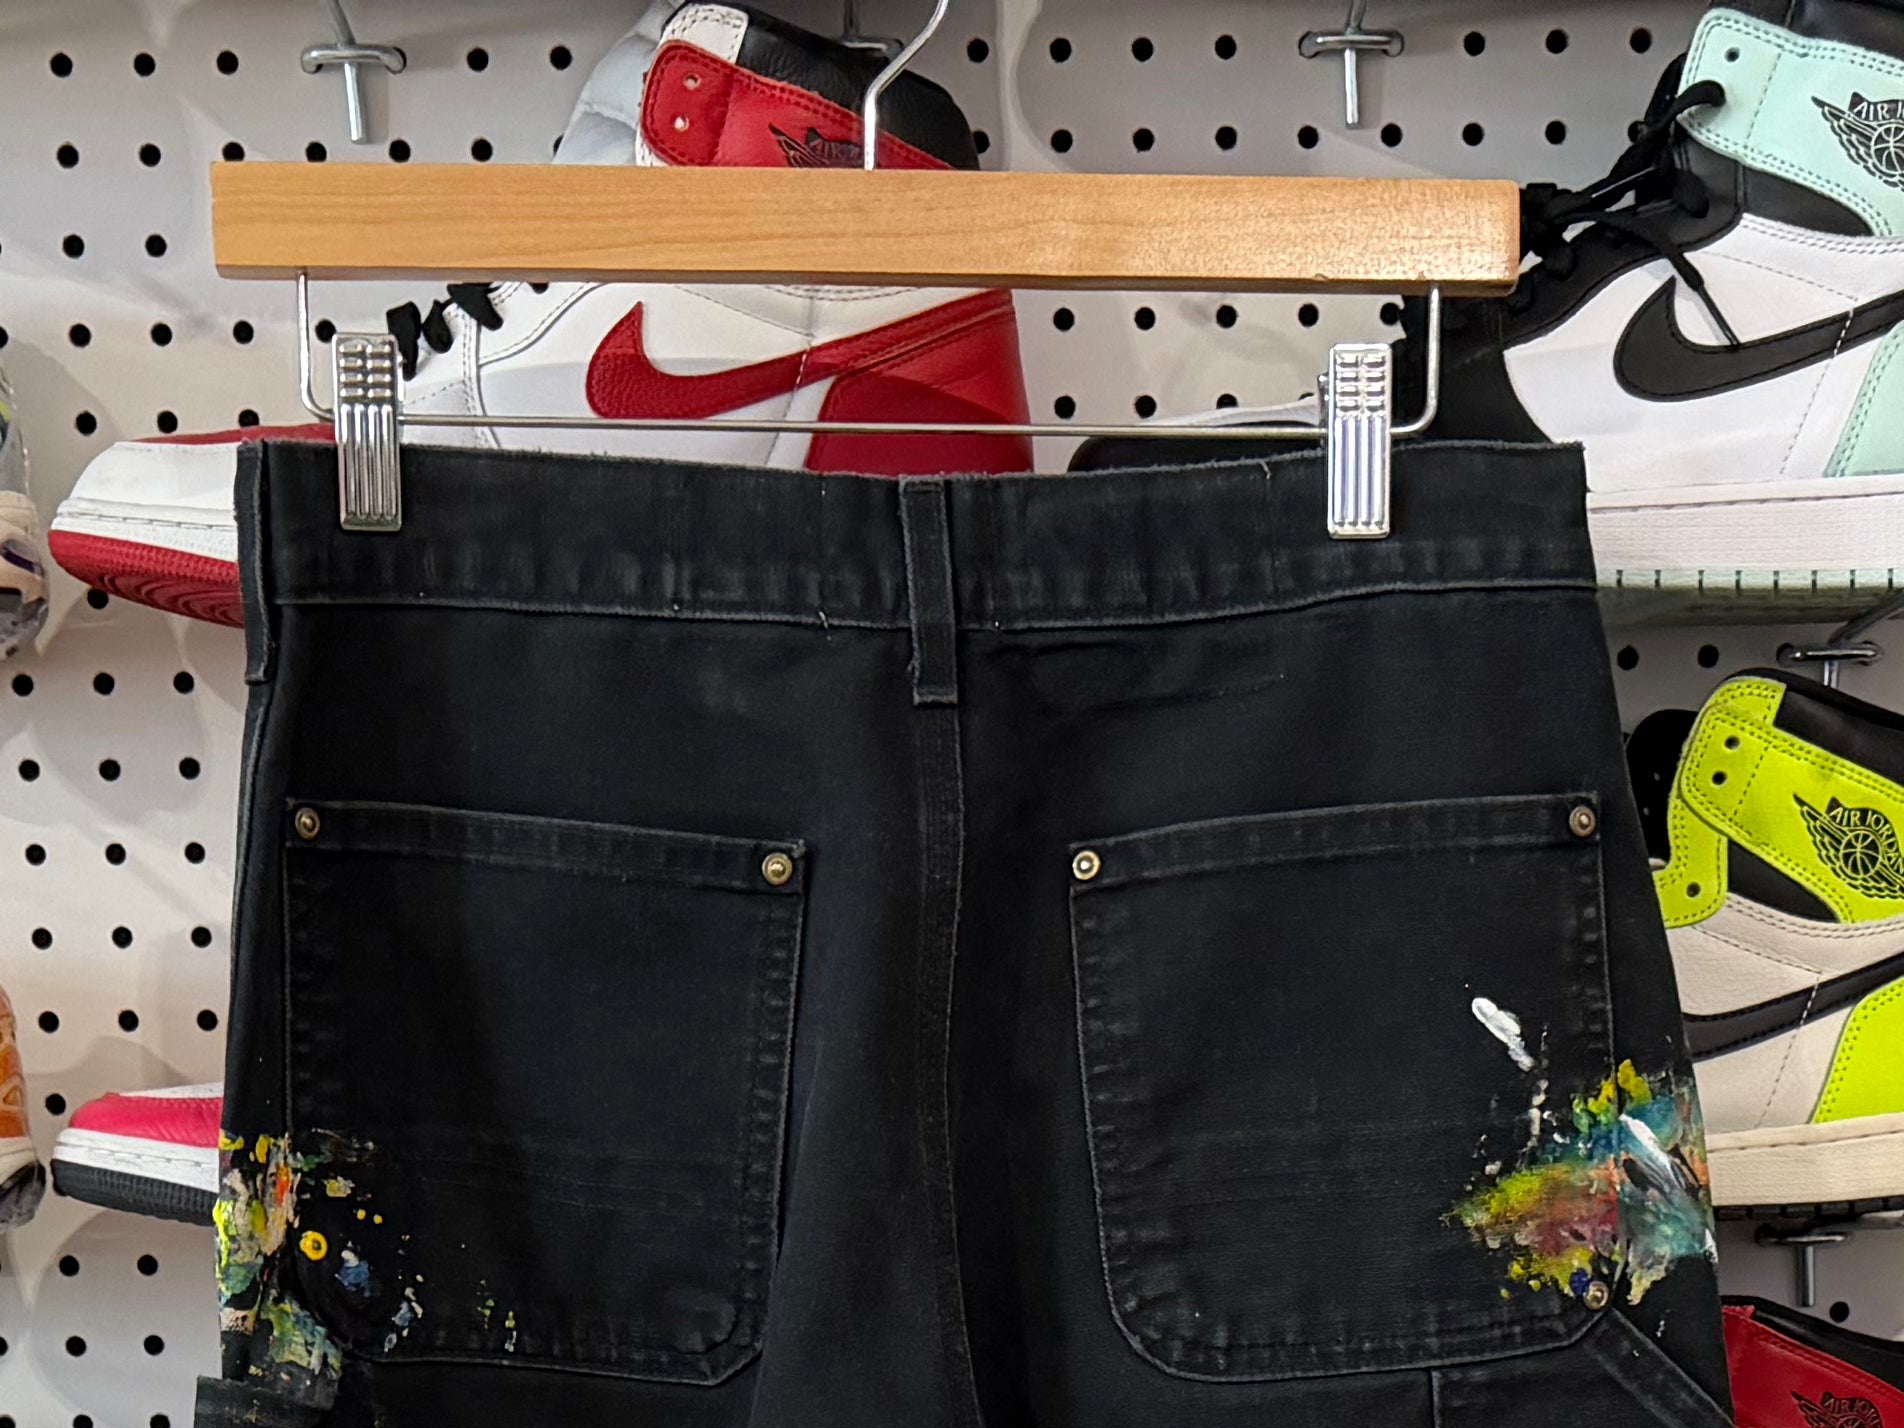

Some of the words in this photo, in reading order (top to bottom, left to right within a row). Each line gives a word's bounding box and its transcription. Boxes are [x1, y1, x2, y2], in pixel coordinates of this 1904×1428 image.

[1851, 100, 1891, 122] AIR
[1828, 806, 1862, 828] AIR
[1822, 1398, 1851, 1414] AIR
